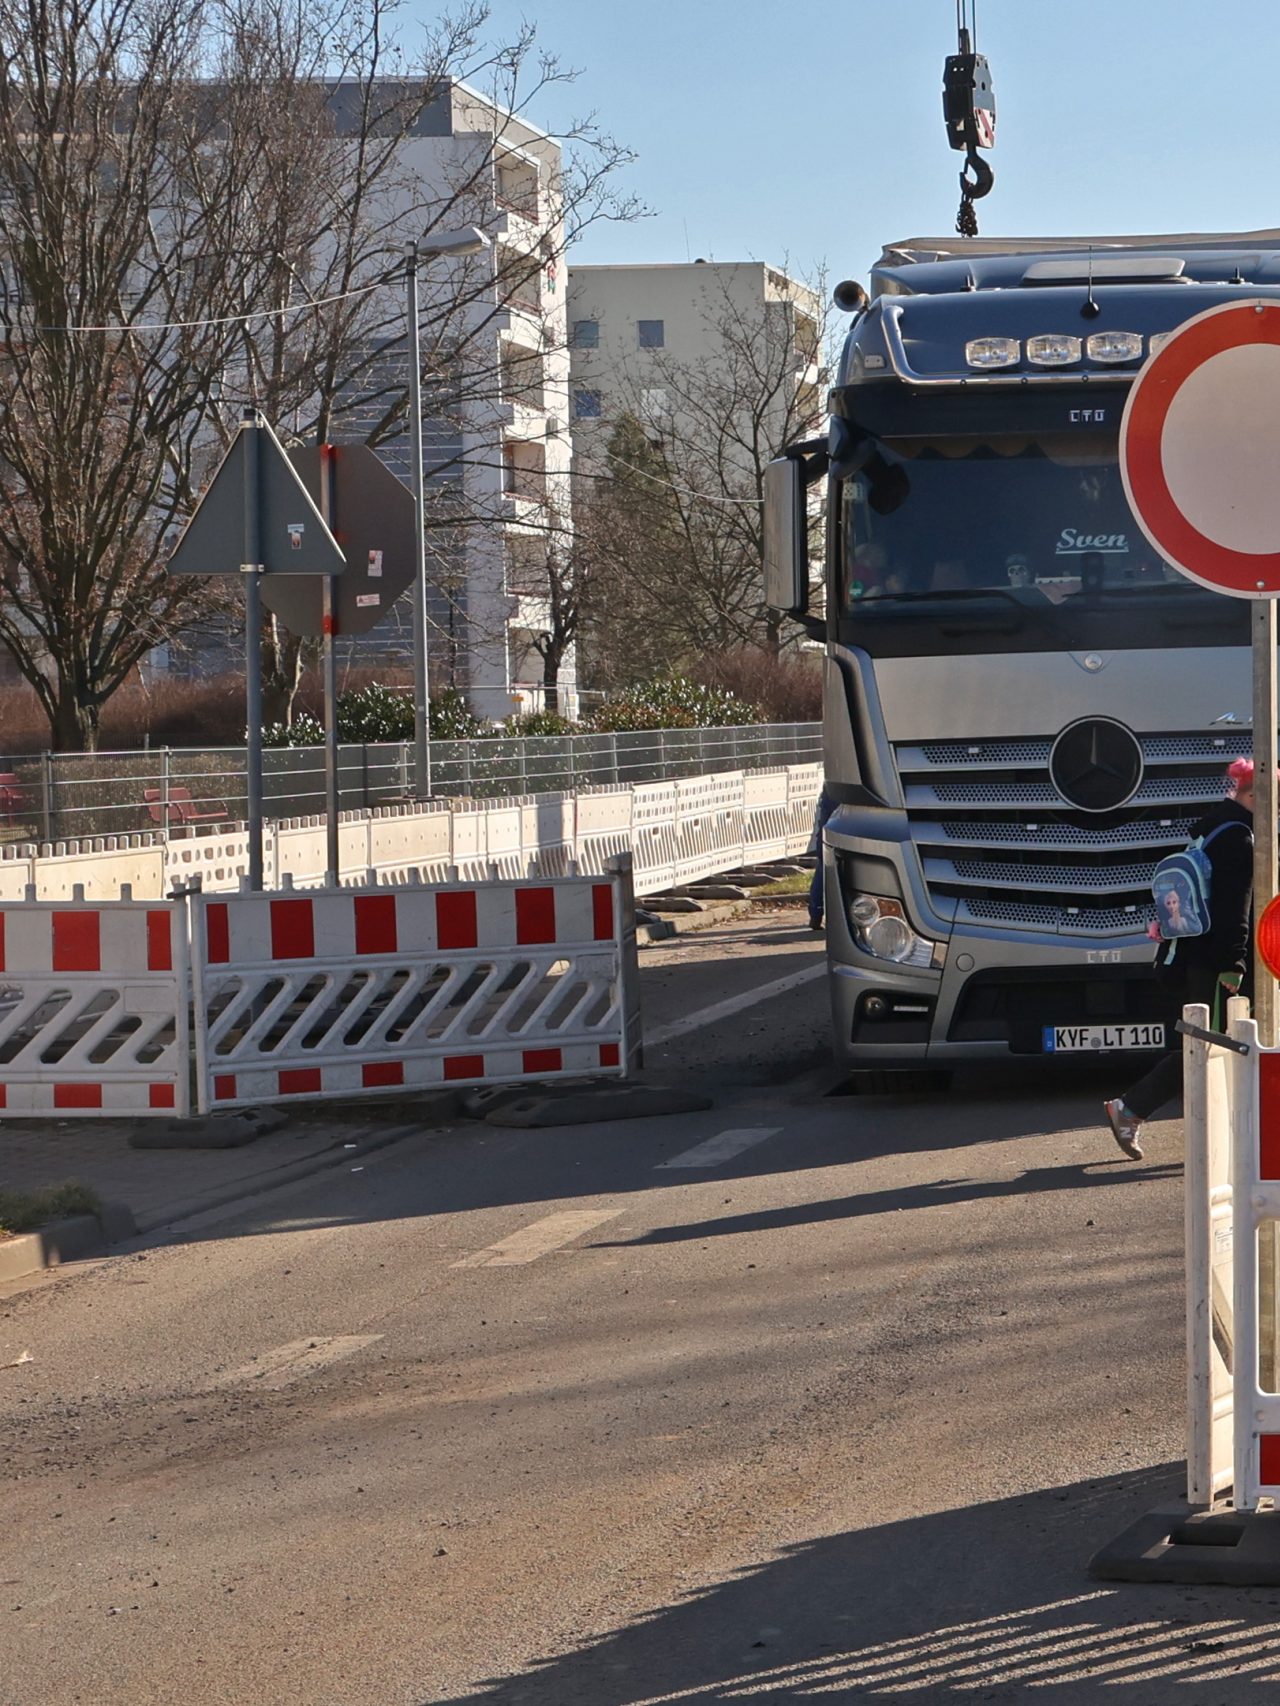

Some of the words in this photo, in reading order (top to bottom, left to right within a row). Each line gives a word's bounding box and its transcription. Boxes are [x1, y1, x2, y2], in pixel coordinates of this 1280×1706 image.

[1056, 528, 1128, 550] Sven
[1056, 1028, 1090, 1048] KYF
[1103, 1027, 1125, 1047] LT
[1130, 1026, 1163, 1046] 110
